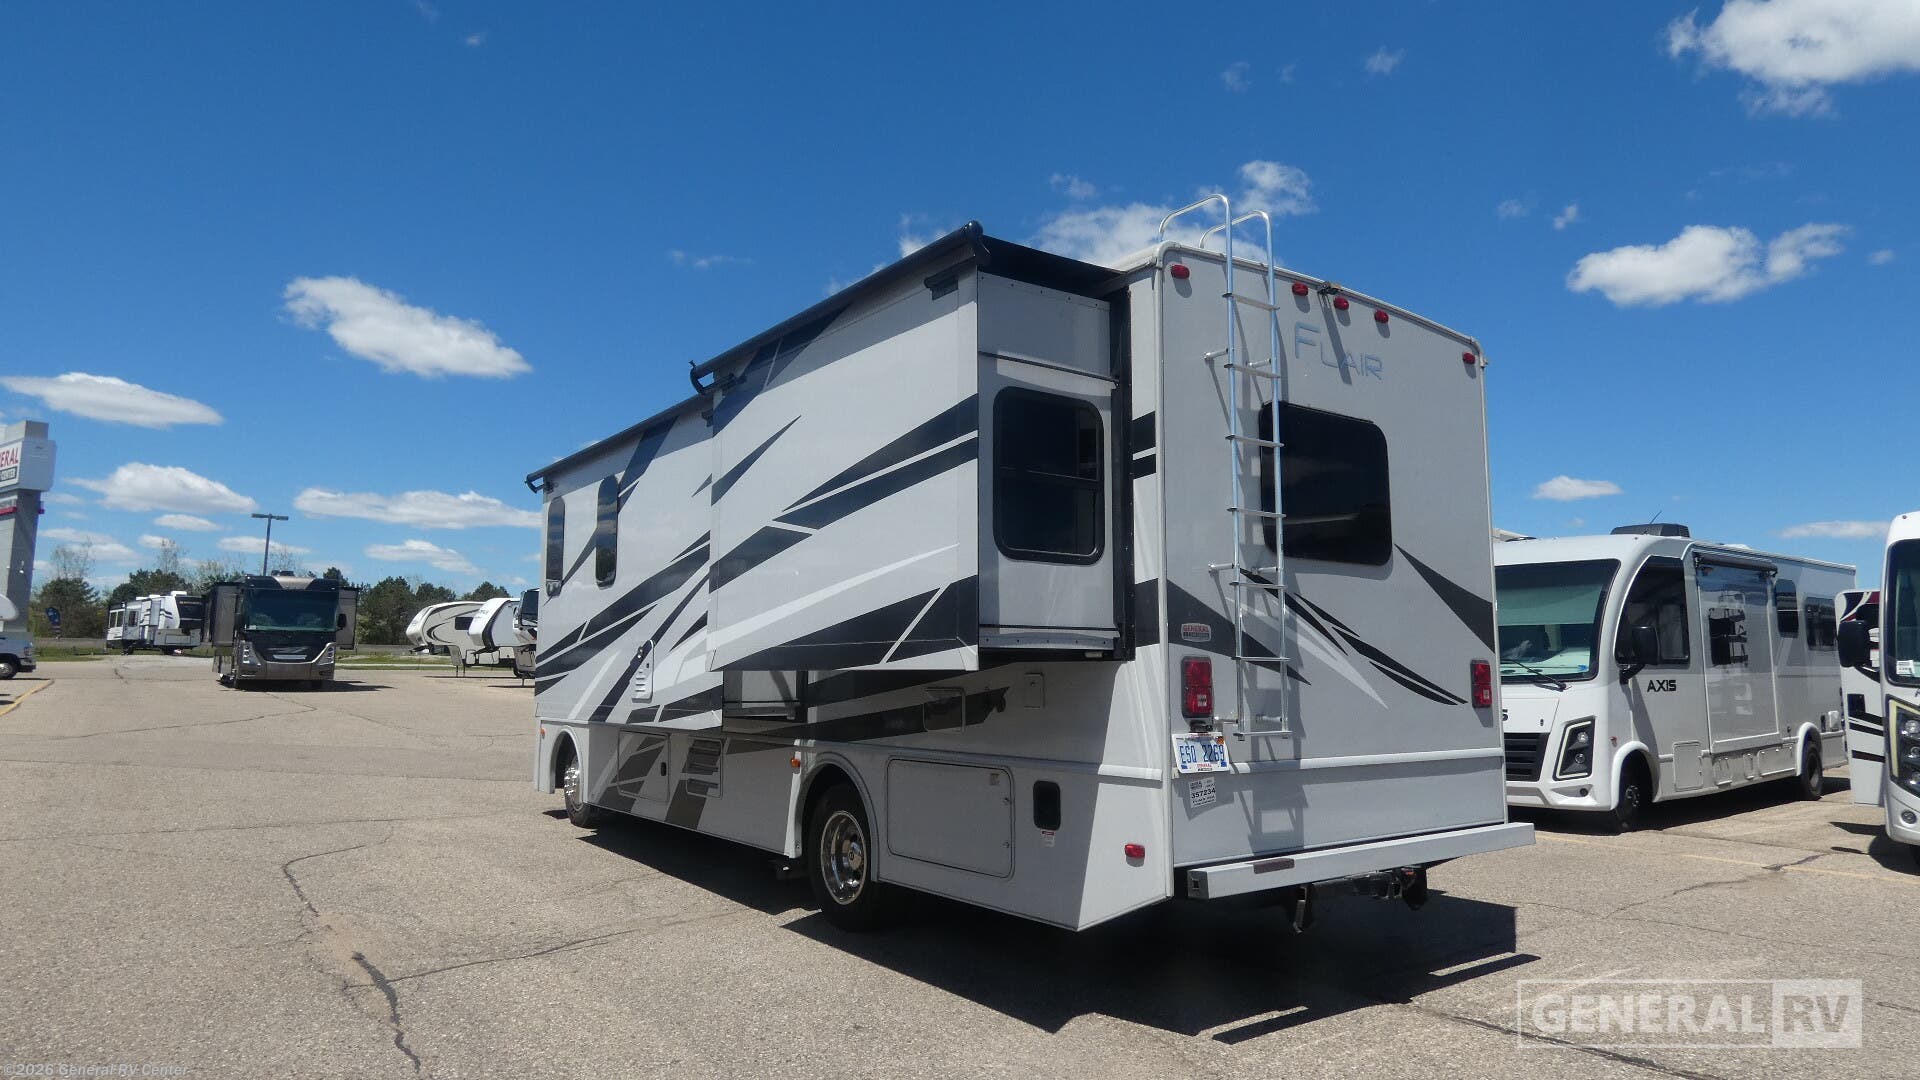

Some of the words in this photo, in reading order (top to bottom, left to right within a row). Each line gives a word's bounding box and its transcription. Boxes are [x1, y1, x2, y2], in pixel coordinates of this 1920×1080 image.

[1295, 321, 1383, 380] FLAIR
[1647, 679, 1677, 693] AXIS
[1202, 744, 1225, 763] 2269
[1191, 787, 1216, 799] 357234
